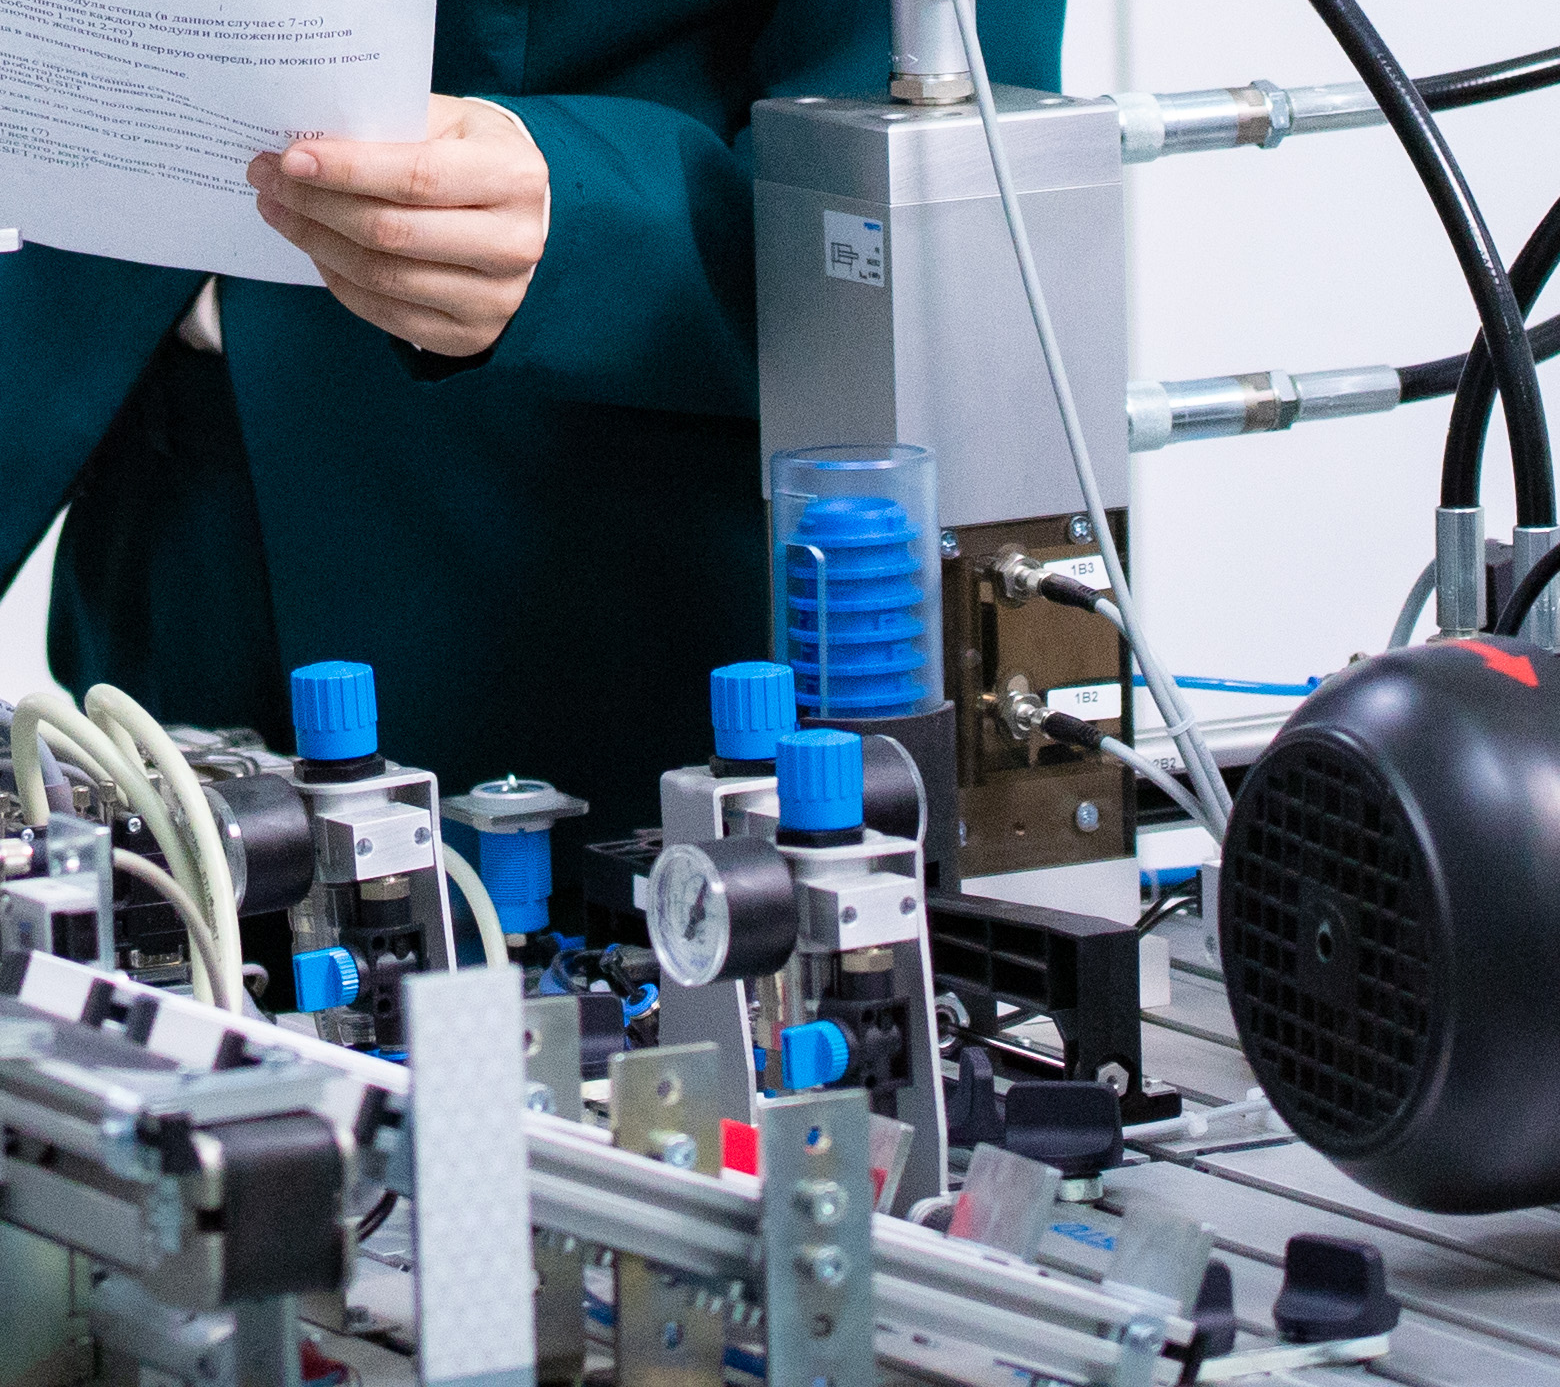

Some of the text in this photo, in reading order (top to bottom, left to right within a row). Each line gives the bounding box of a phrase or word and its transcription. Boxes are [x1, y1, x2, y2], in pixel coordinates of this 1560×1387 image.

[282, 128, 326, 141] STOP
[1070, 561, 1096, 577] 1B3
[1073, 690, 1100, 704] 1B2
